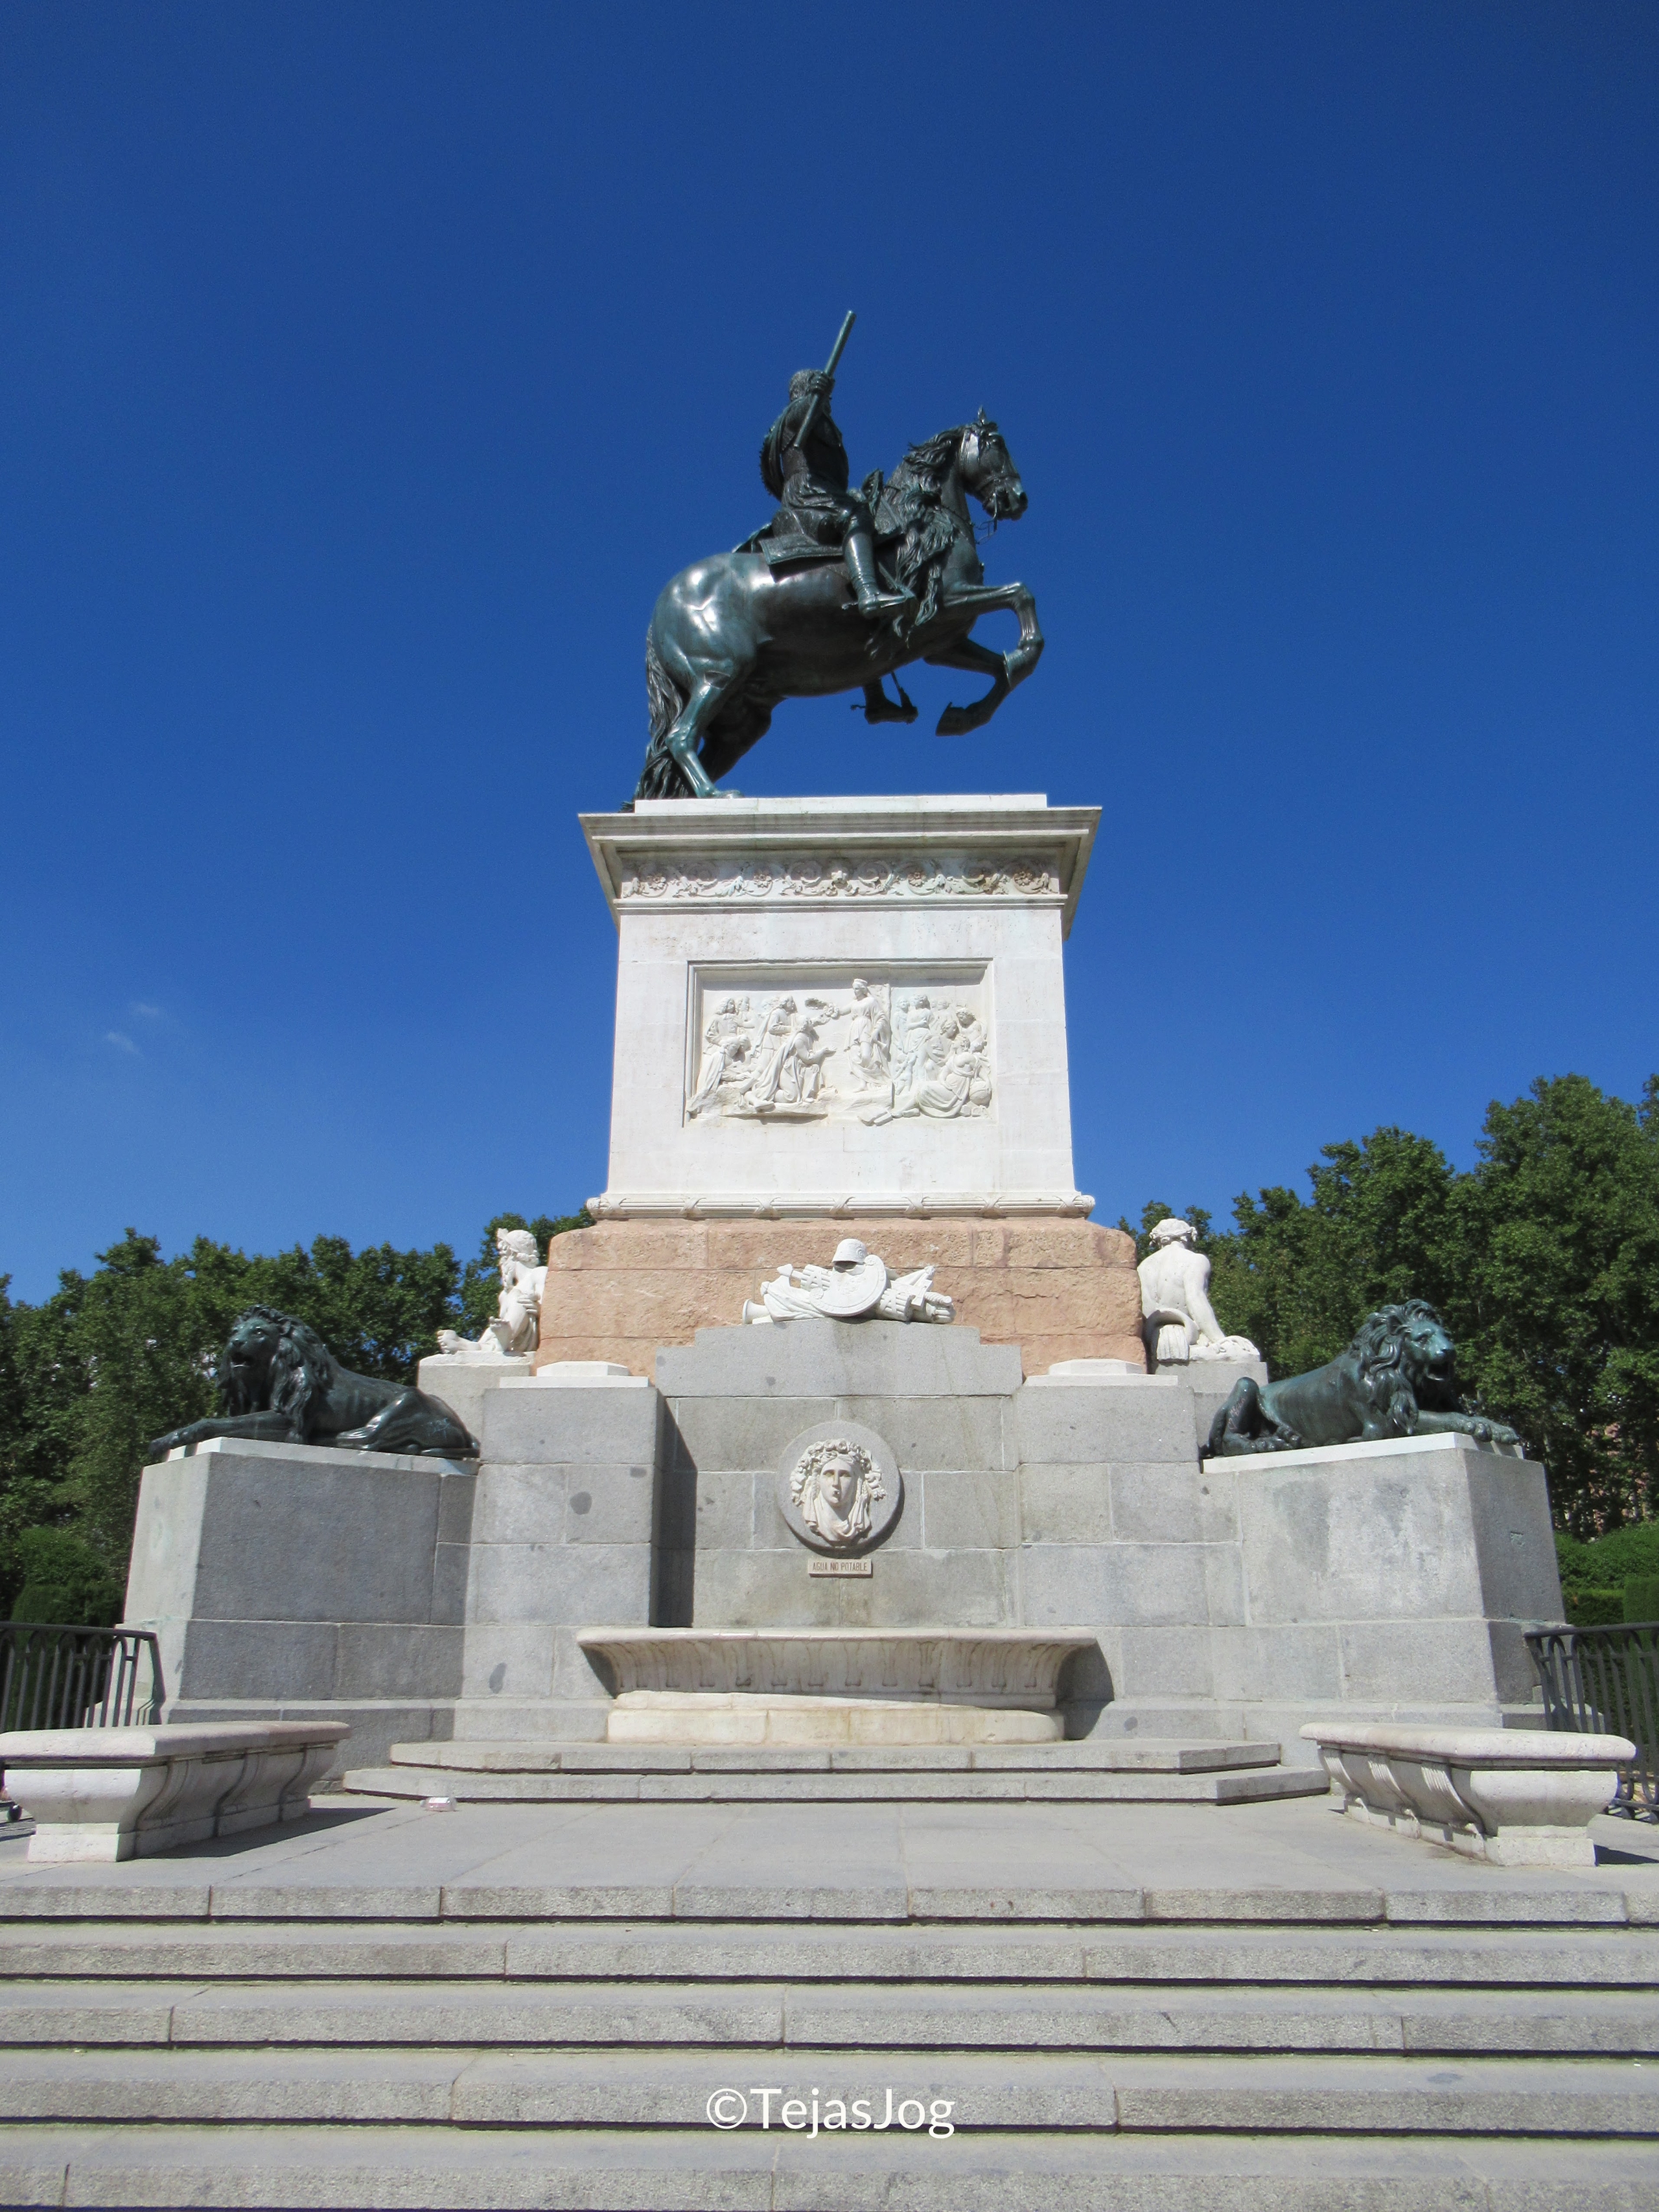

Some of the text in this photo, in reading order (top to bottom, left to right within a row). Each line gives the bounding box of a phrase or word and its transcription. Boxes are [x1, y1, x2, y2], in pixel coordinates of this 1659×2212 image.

[813, 1562, 868, 1571] AGUA NO POTABLE
